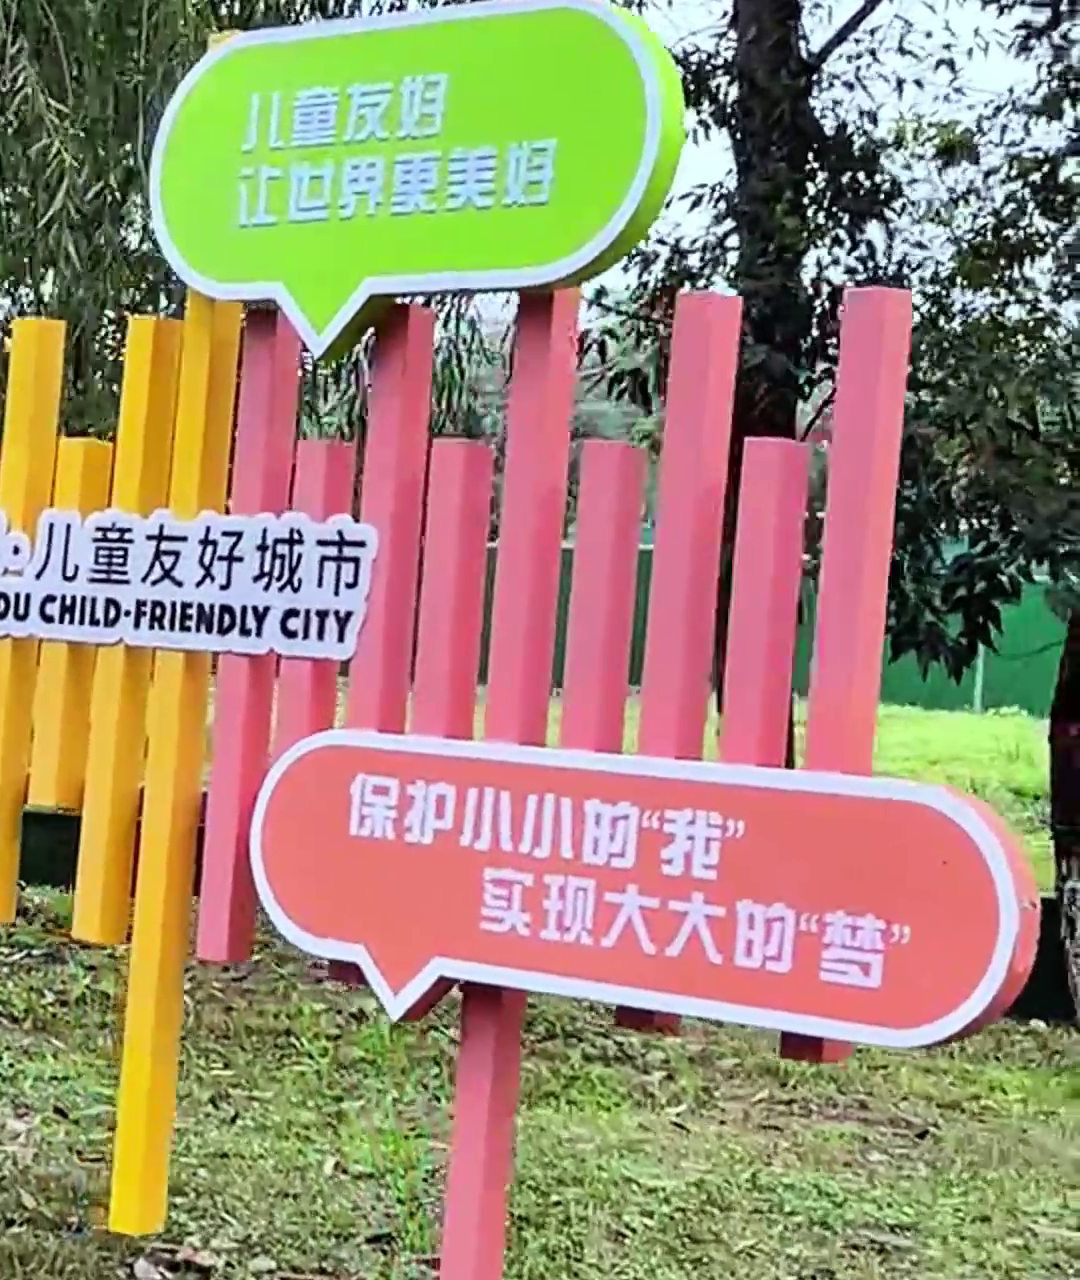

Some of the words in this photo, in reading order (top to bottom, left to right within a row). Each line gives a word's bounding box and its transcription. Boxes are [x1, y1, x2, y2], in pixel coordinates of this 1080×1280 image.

[240, 73, 450, 153] 儿童友好
[236, 138, 558, 228] 让世界更美好
[279, 606, 354, 644] CITY
